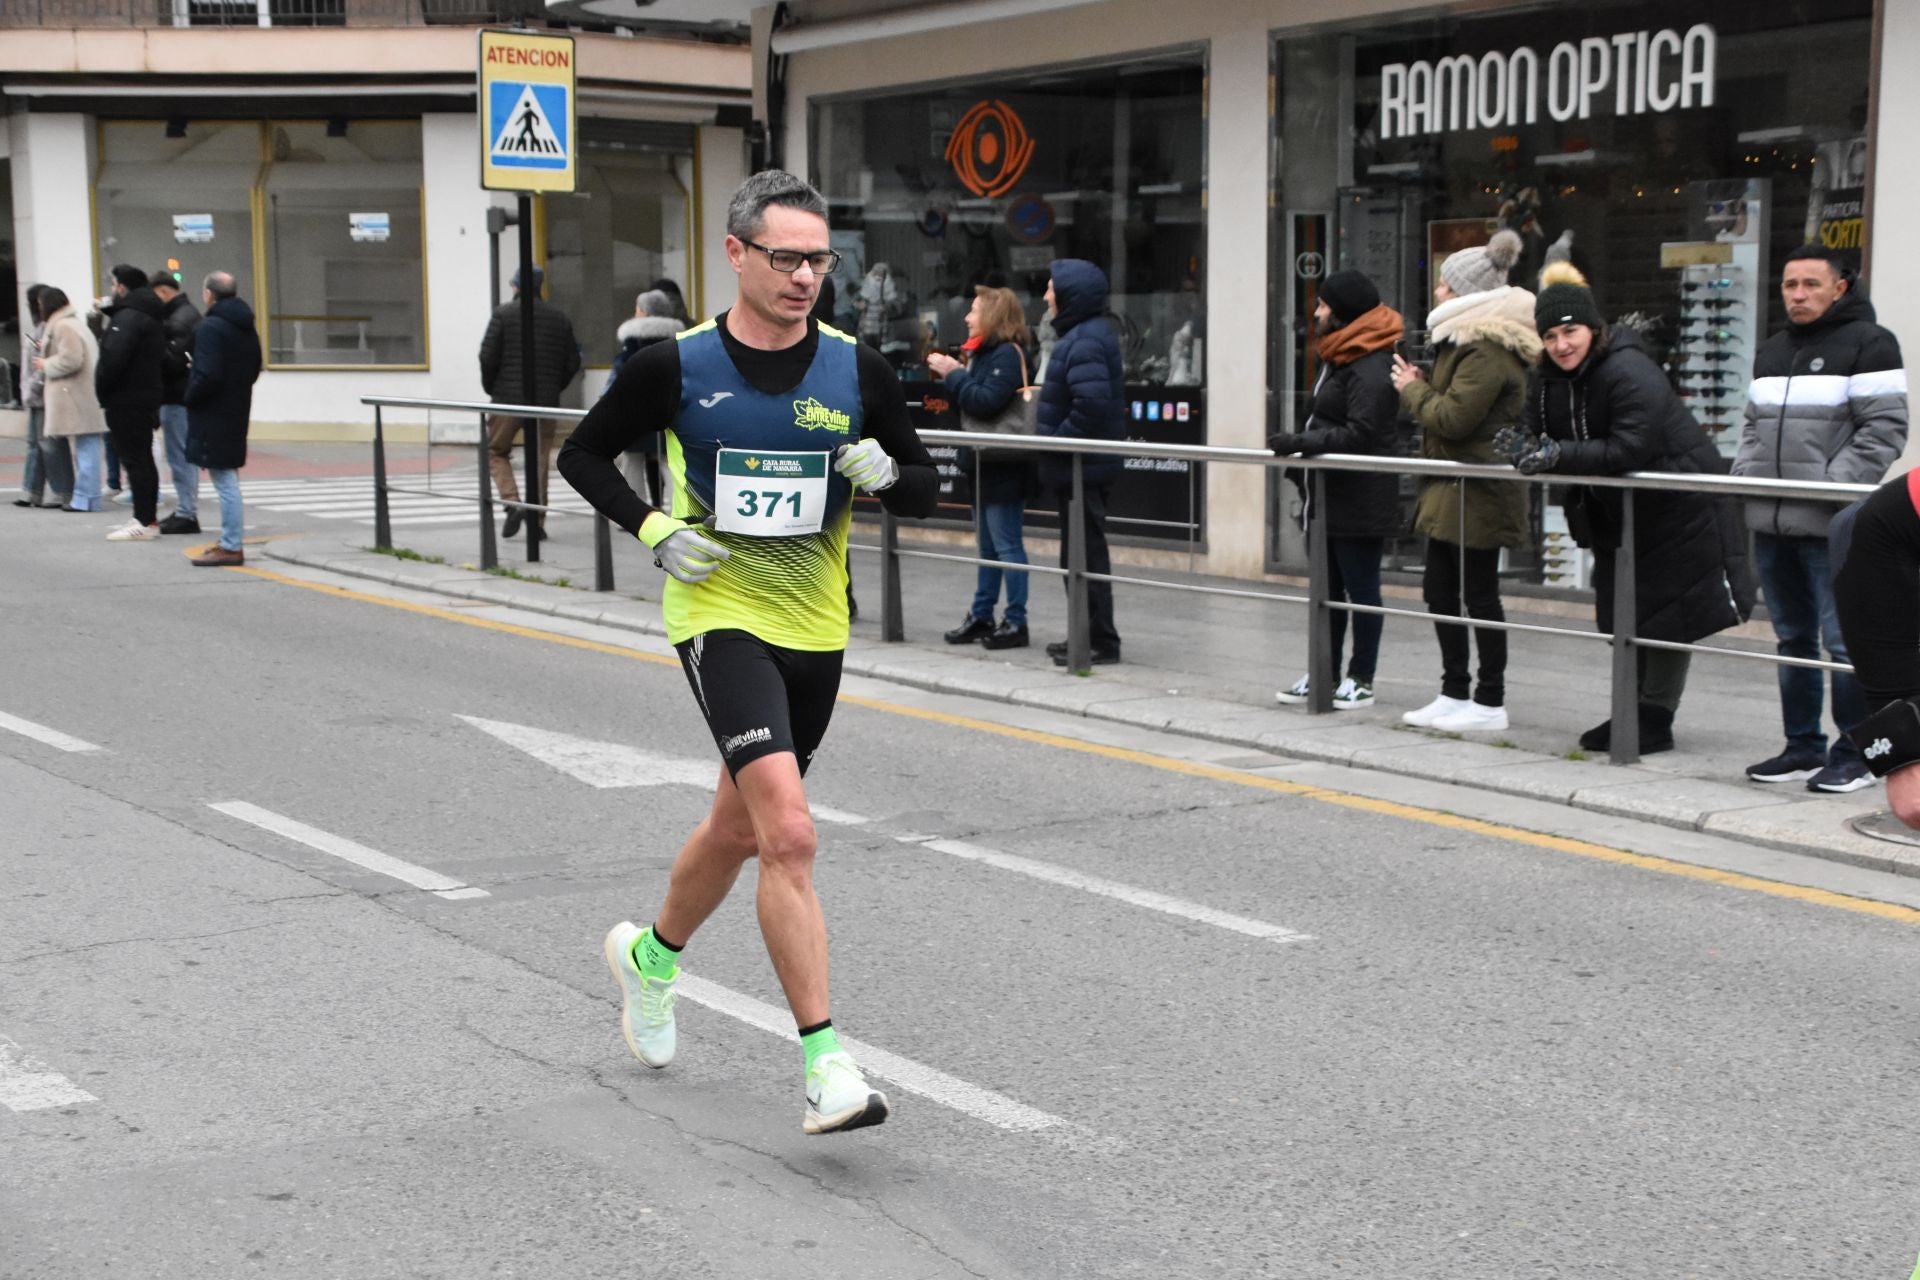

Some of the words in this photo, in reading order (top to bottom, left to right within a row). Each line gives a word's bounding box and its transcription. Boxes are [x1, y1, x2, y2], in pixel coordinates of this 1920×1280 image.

[487, 45, 569, 68] ATENCION
[1381, 46, 1538, 139] RAMON
[1548, 23, 1716, 122] OPTICA
[736, 489, 802, 518] 371
